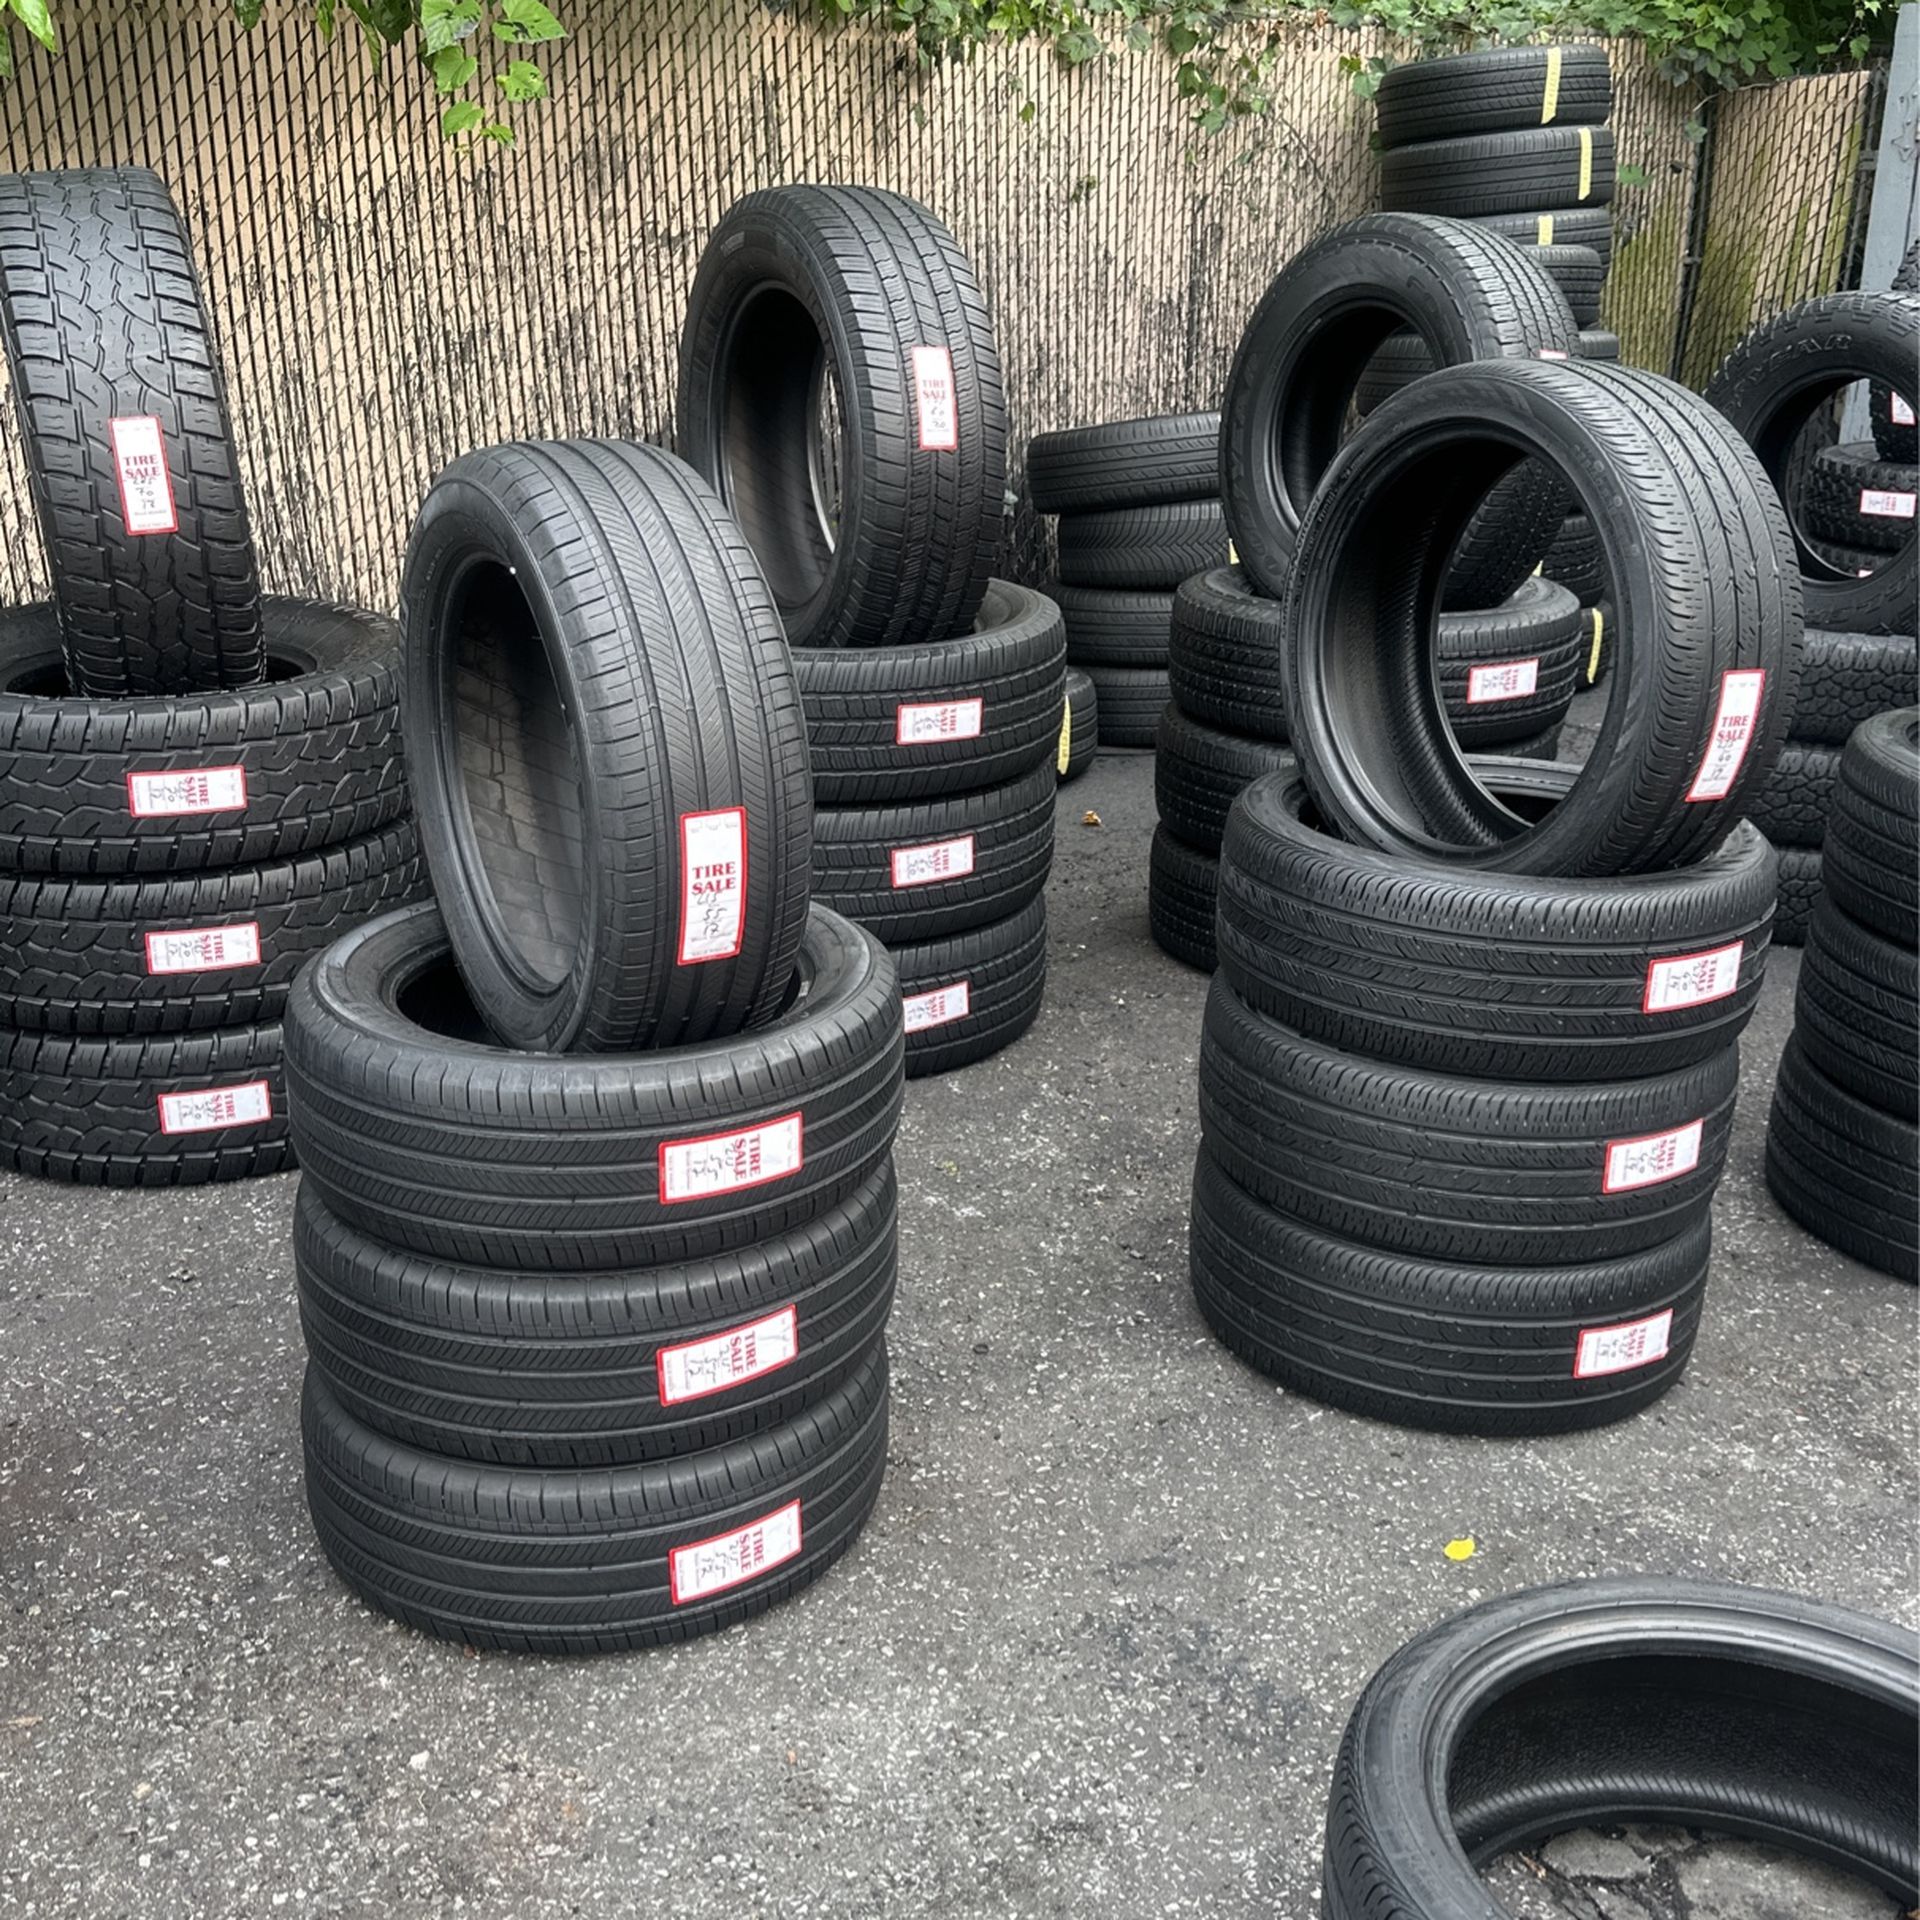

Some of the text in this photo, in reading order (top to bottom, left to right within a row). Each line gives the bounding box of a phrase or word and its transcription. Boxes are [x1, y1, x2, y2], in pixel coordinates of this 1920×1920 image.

[922, 379, 945, 389] TIRE
[922, 390, 946, 400] SALE
[123, 454, 159, 467] TIRE
[125, 465, 161, 480] SALE
[1717, 729, 1746, 742] SALE
[1720, 715, 1750, 728] TIRE
[185, 776, 198, 807] SALE
[198, 776, 210, 806] TIRE
[691, 861, 737, 880] TIRE
[933, 849, 941, 874] SALE
[690, 877, 737, 895] SALE
[702, 907, 728, 922] 55
[202, 934, 213, 964] SALE
[213, 933, 224, 962] TIRE
[1696, 959, 1708, 996] SALE
[1706, 957, 1718, 993] TIRE
[213, 1094, 225, 1122] SALE
[224, 1092, 236, 1119] TIRE
[734, 1137, 747, 1181] SALE
[749, 1134, 760, 1177] TIRE
[1656, 1139, 1667, 1172] SALE
[1666, 1137, 1677, 1168] TIRE
[707, 1154, 722, 1181] 55
[744, 1330, 758, 1372] TIRE
[1626, 1328, 1637, 1360] SALE
[1636, 1326, 1647, 1356] TIRE
[704, 1356, 717, 1384] 55
[730, 1335, 743, 1377] SALE
[740, 1533, 752, 1573] SALE
[753, 1527, 764, 1567] TIRE
[715, 1552, 727, 1579] 55
